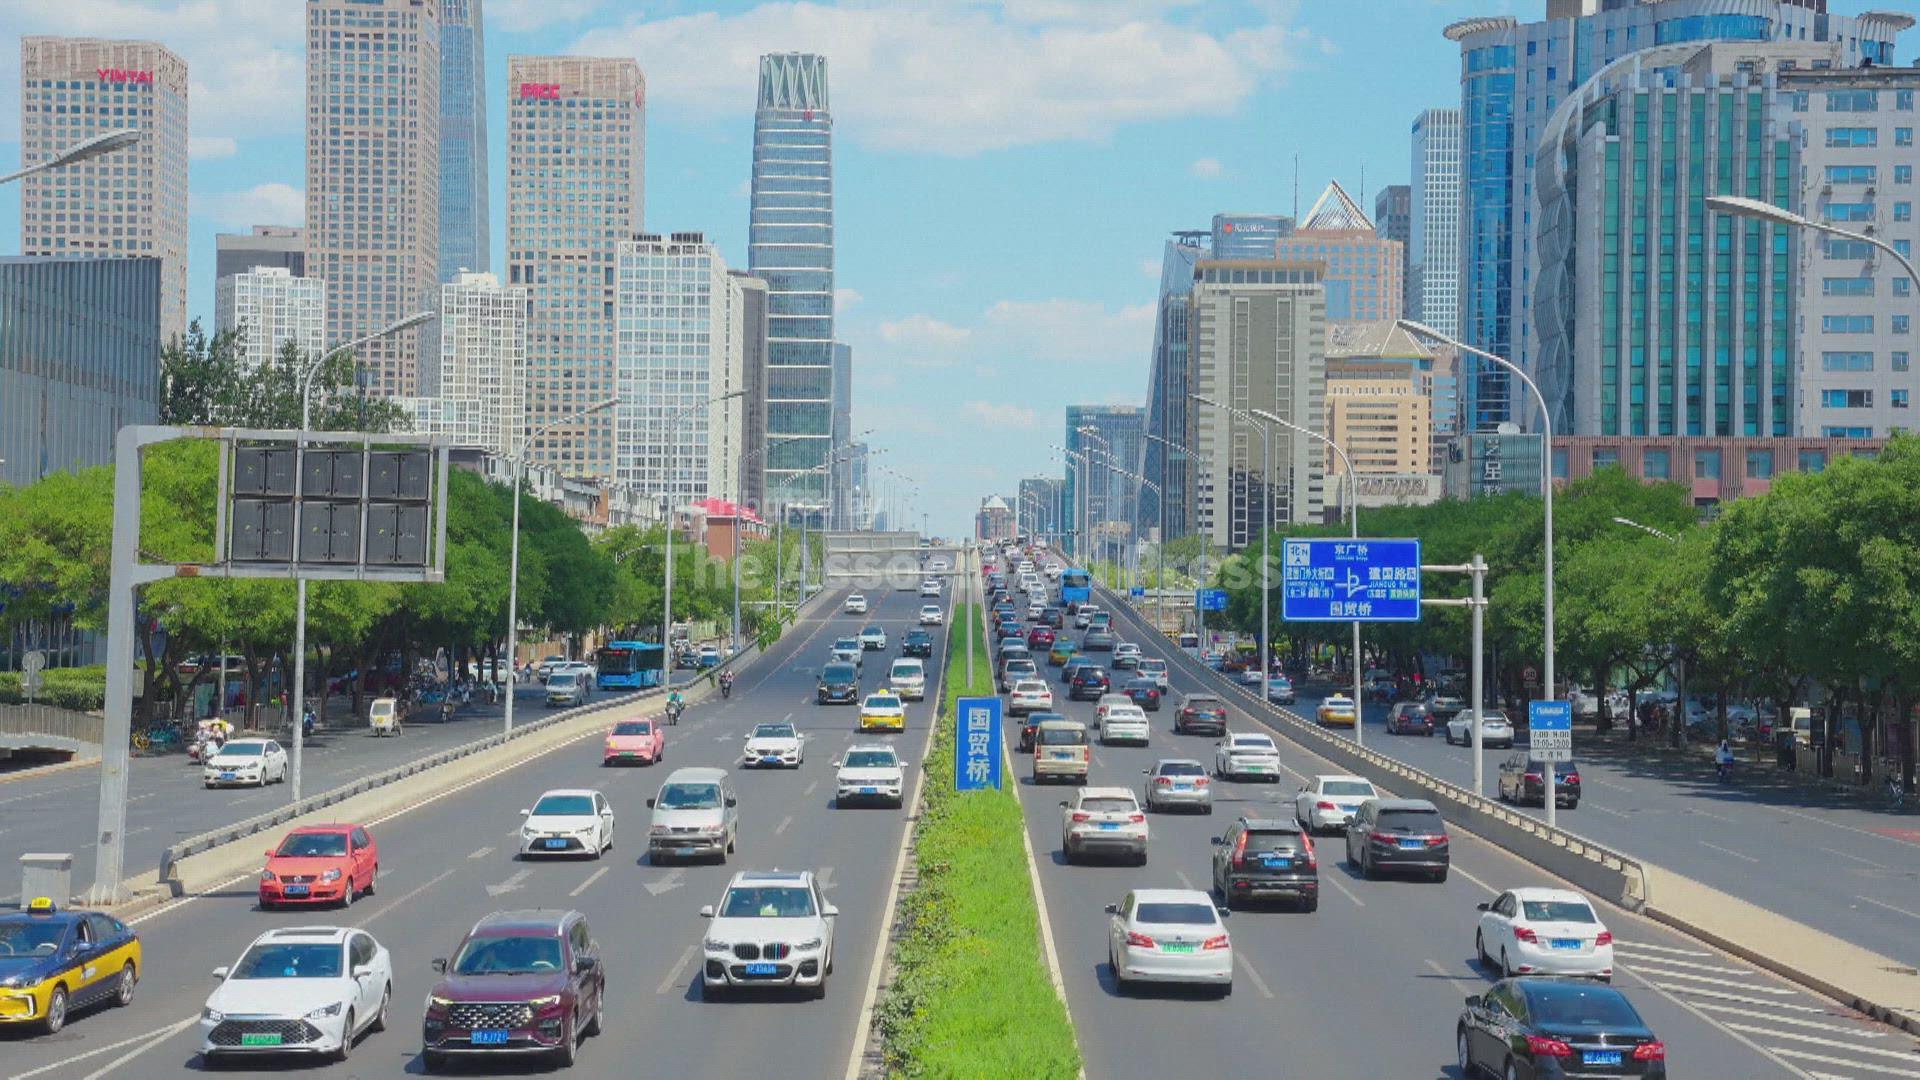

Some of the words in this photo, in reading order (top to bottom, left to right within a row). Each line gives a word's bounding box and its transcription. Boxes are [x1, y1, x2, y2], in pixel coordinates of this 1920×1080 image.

[97, 68, 154, 83] YINTAI
[1330, 601, 1372, 617] 国贸桥
[966, 706, 991, 783] 国贸桥
